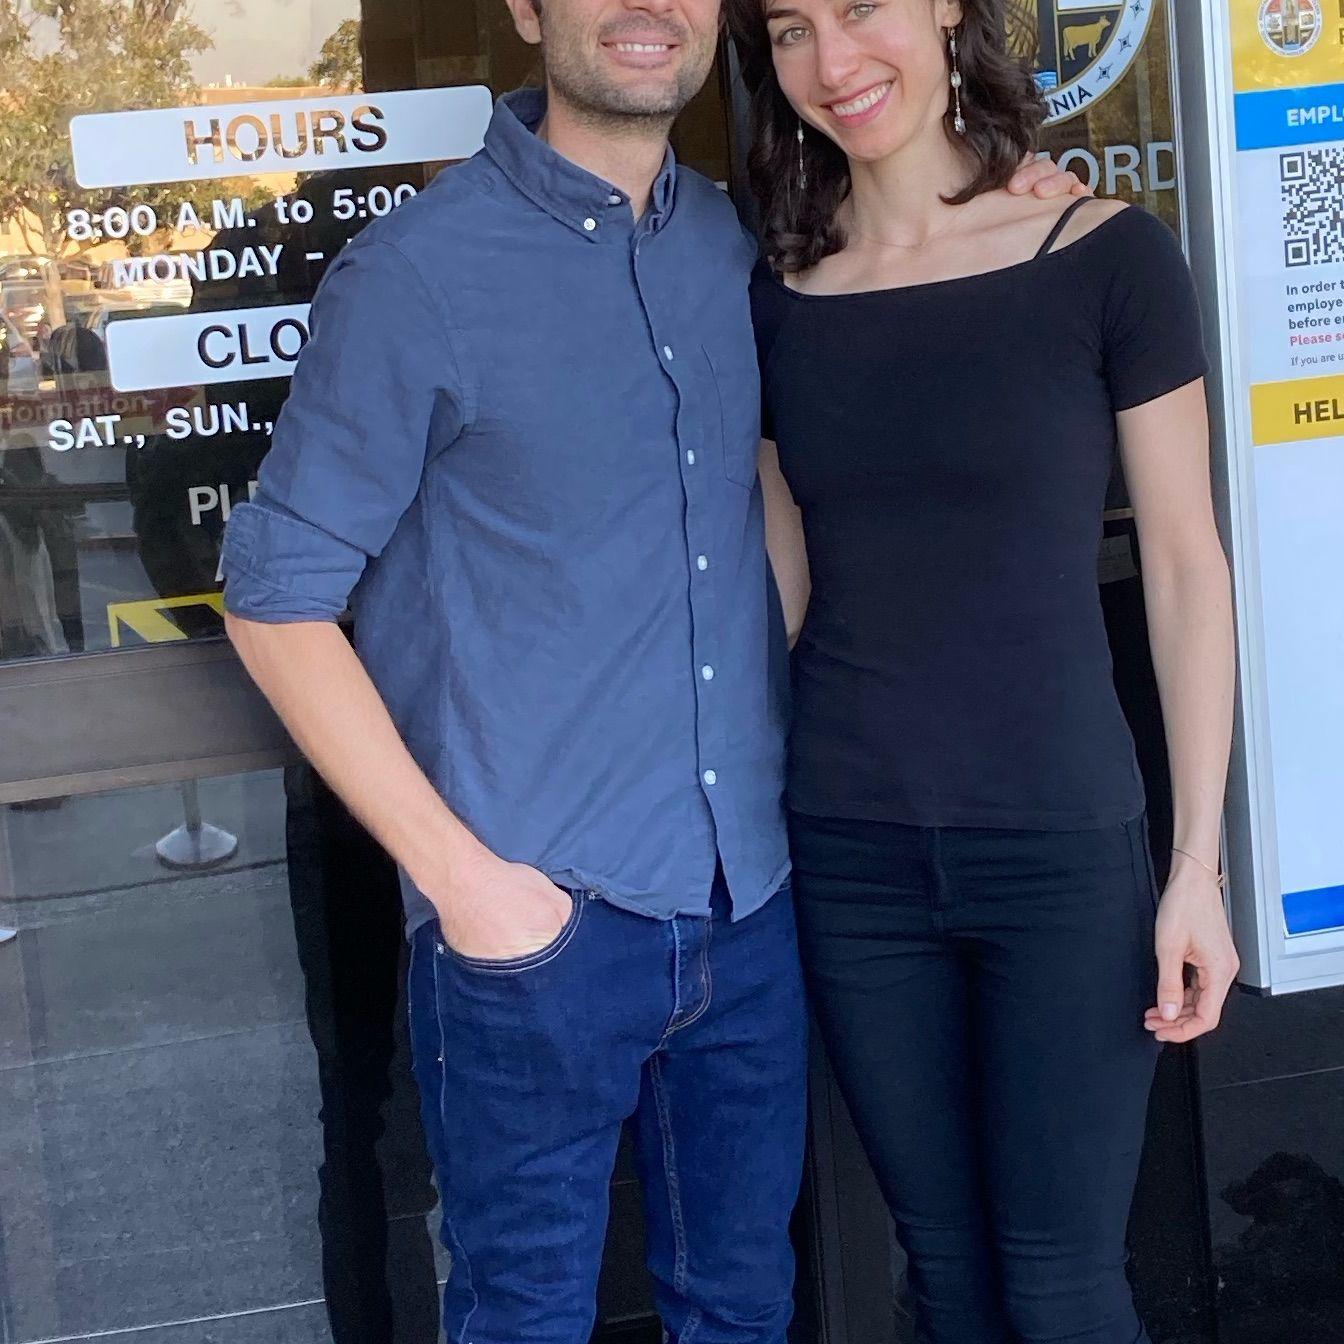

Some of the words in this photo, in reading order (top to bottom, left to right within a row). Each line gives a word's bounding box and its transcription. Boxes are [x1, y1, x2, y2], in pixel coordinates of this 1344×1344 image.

[184, 105, 387, 166] HOURS
[66, 203, 157, 241] 8:00
[177, 197, 257, 233] A.M.
[274, 197, 314, 225] to
[113, 244, 283, 289] MONDAY
[1286, 285, 1298, 295] In
[1301, 280, 1336, 293] order
[1288, 309, 1331, 329] before
[1289, 334, 1332, 346] Please
[198, 318, 309, 368] CLO
[48, 414, 145, 451] SAT.,
[165, 401, 273, 439] SUN.,
